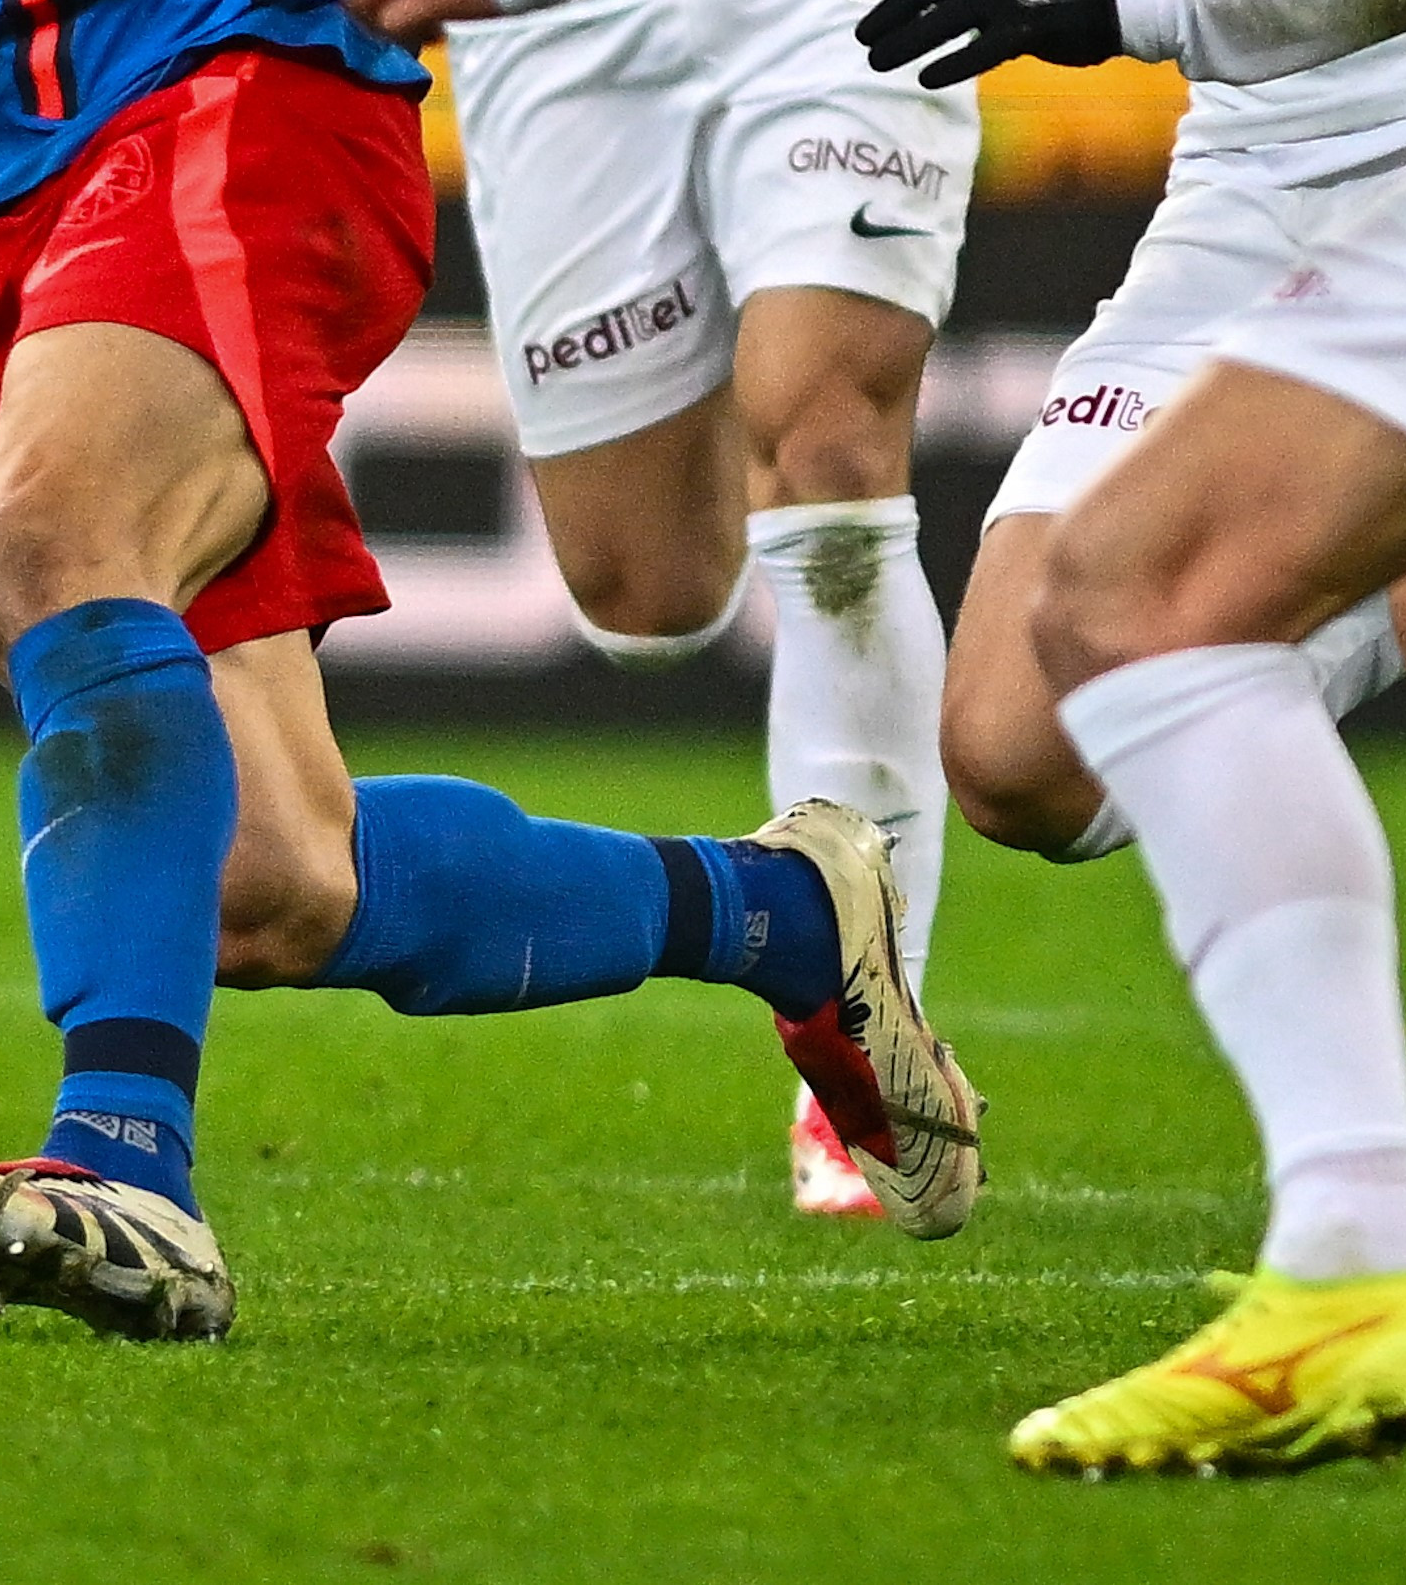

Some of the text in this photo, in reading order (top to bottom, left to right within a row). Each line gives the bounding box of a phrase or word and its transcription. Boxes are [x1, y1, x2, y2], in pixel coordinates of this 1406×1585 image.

[788, 138, 949, 200] GINSAVIT
[524, 280, 696, 385] peditel
[1041, 384, 1166, 431] edit
